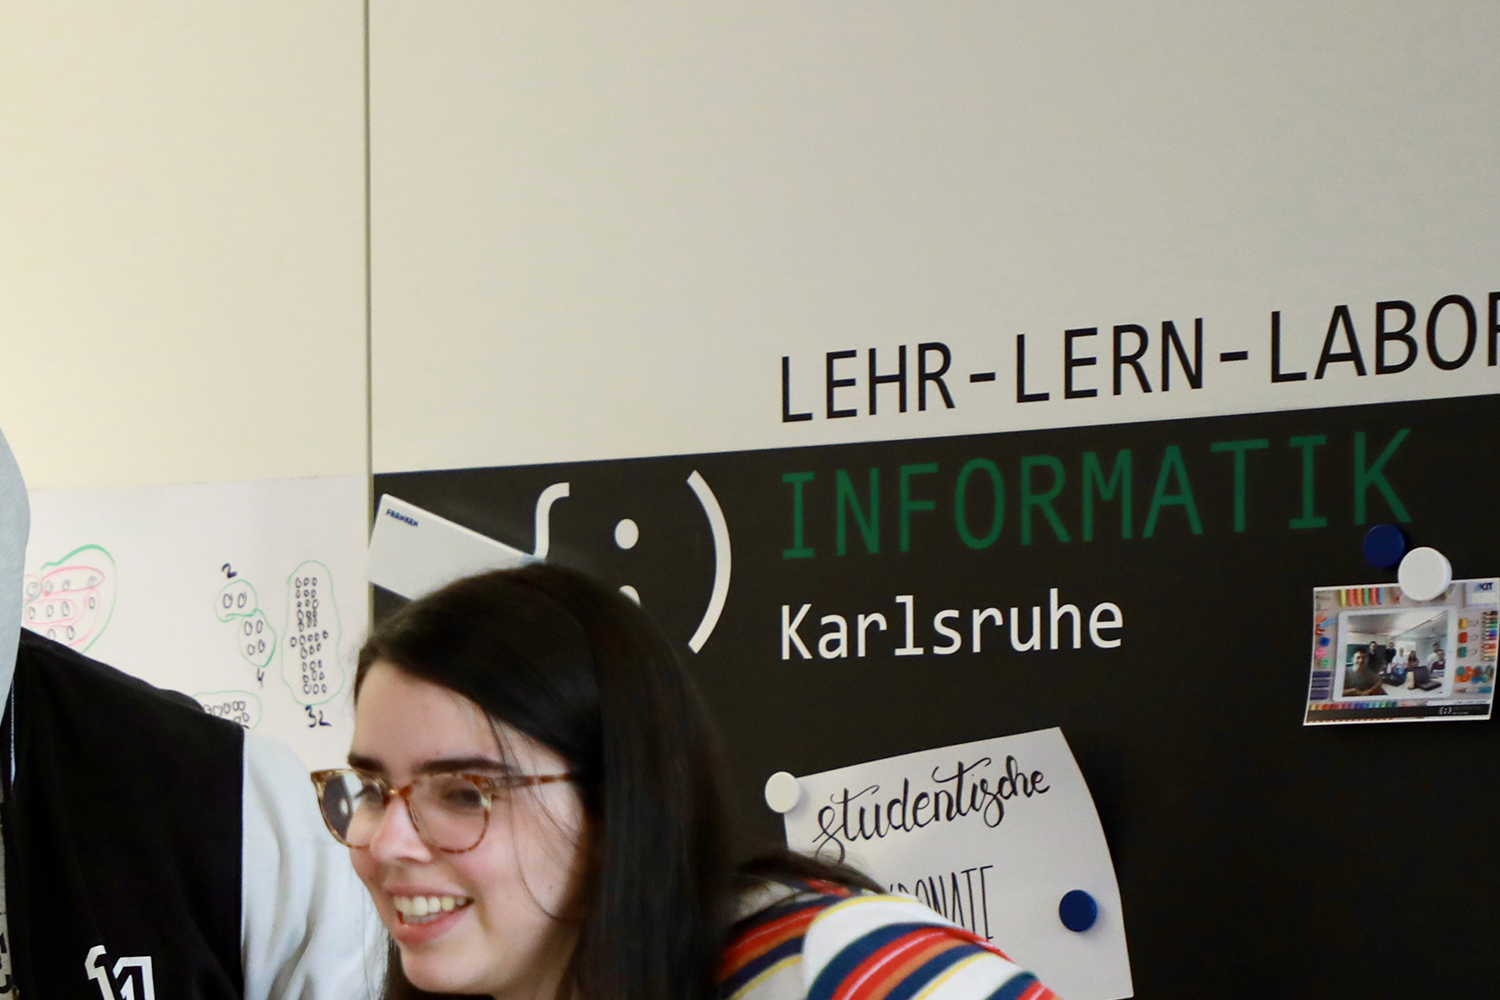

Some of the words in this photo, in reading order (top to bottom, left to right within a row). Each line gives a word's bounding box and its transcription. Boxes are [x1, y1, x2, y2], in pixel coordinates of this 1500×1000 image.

[385, 508, 420, 528] FRANKEN
[782, 428, 1412, 560] INFORMATIK
[781, 588, 1124, 661] Karlsruhe
[812, 754, 1051, 868] studentische
